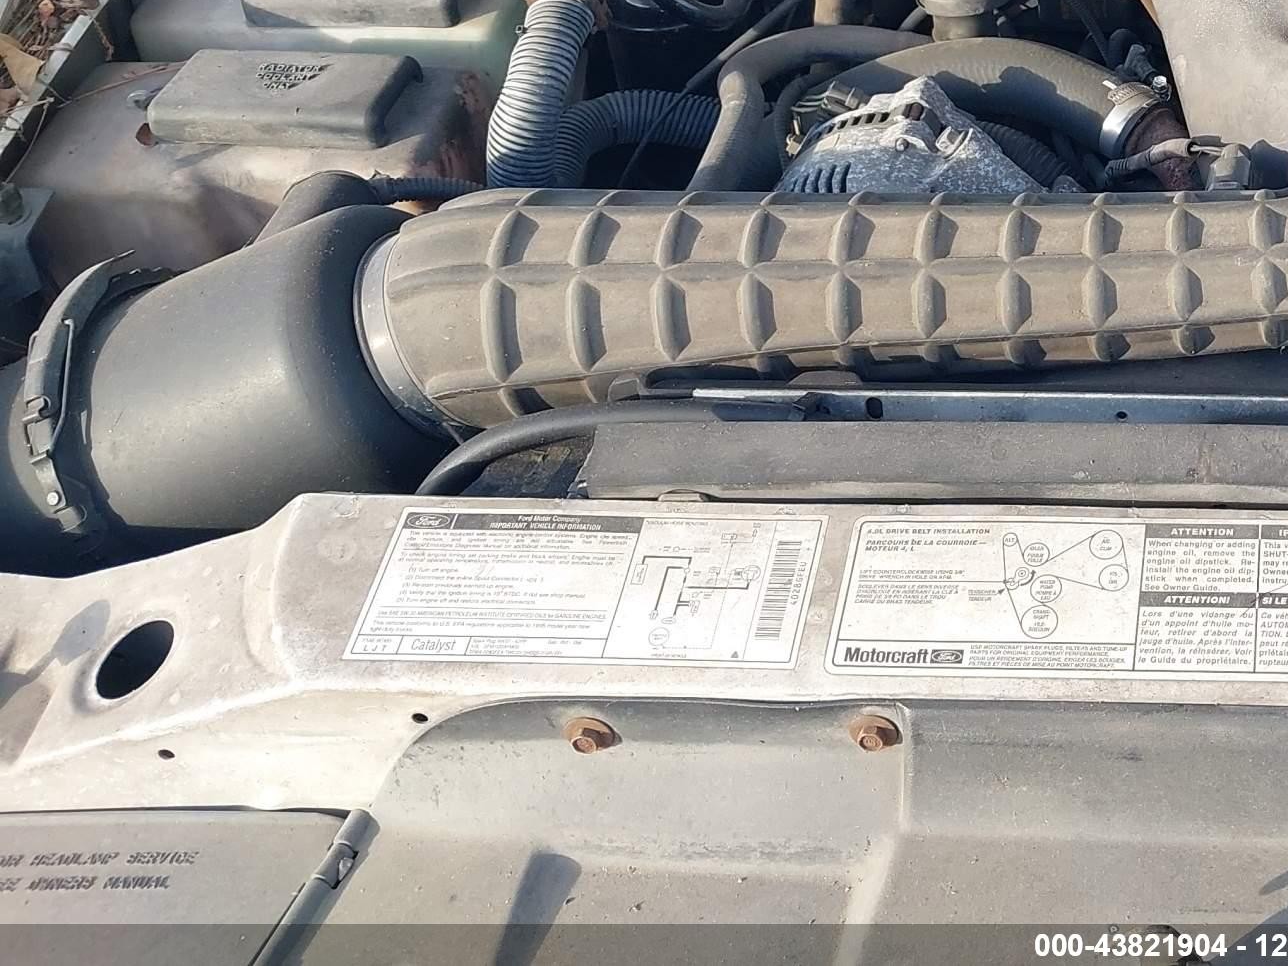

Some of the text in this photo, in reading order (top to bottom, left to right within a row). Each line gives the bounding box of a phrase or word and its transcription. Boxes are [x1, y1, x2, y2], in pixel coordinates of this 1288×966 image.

[260, 63, 321, 72] RADIATOR
[256, 73, 310, 81] COOLANT
[264, 82, 290, 90] ONLY
[415, 516, 441, 526] Ford
[1175, 541, 1213, 549] changing
[1164, 596, 1230, 604] ATTENTION!
[411, 638, 456, 652] Catalyst
[844, 646, 928, 664] Motorcraft
